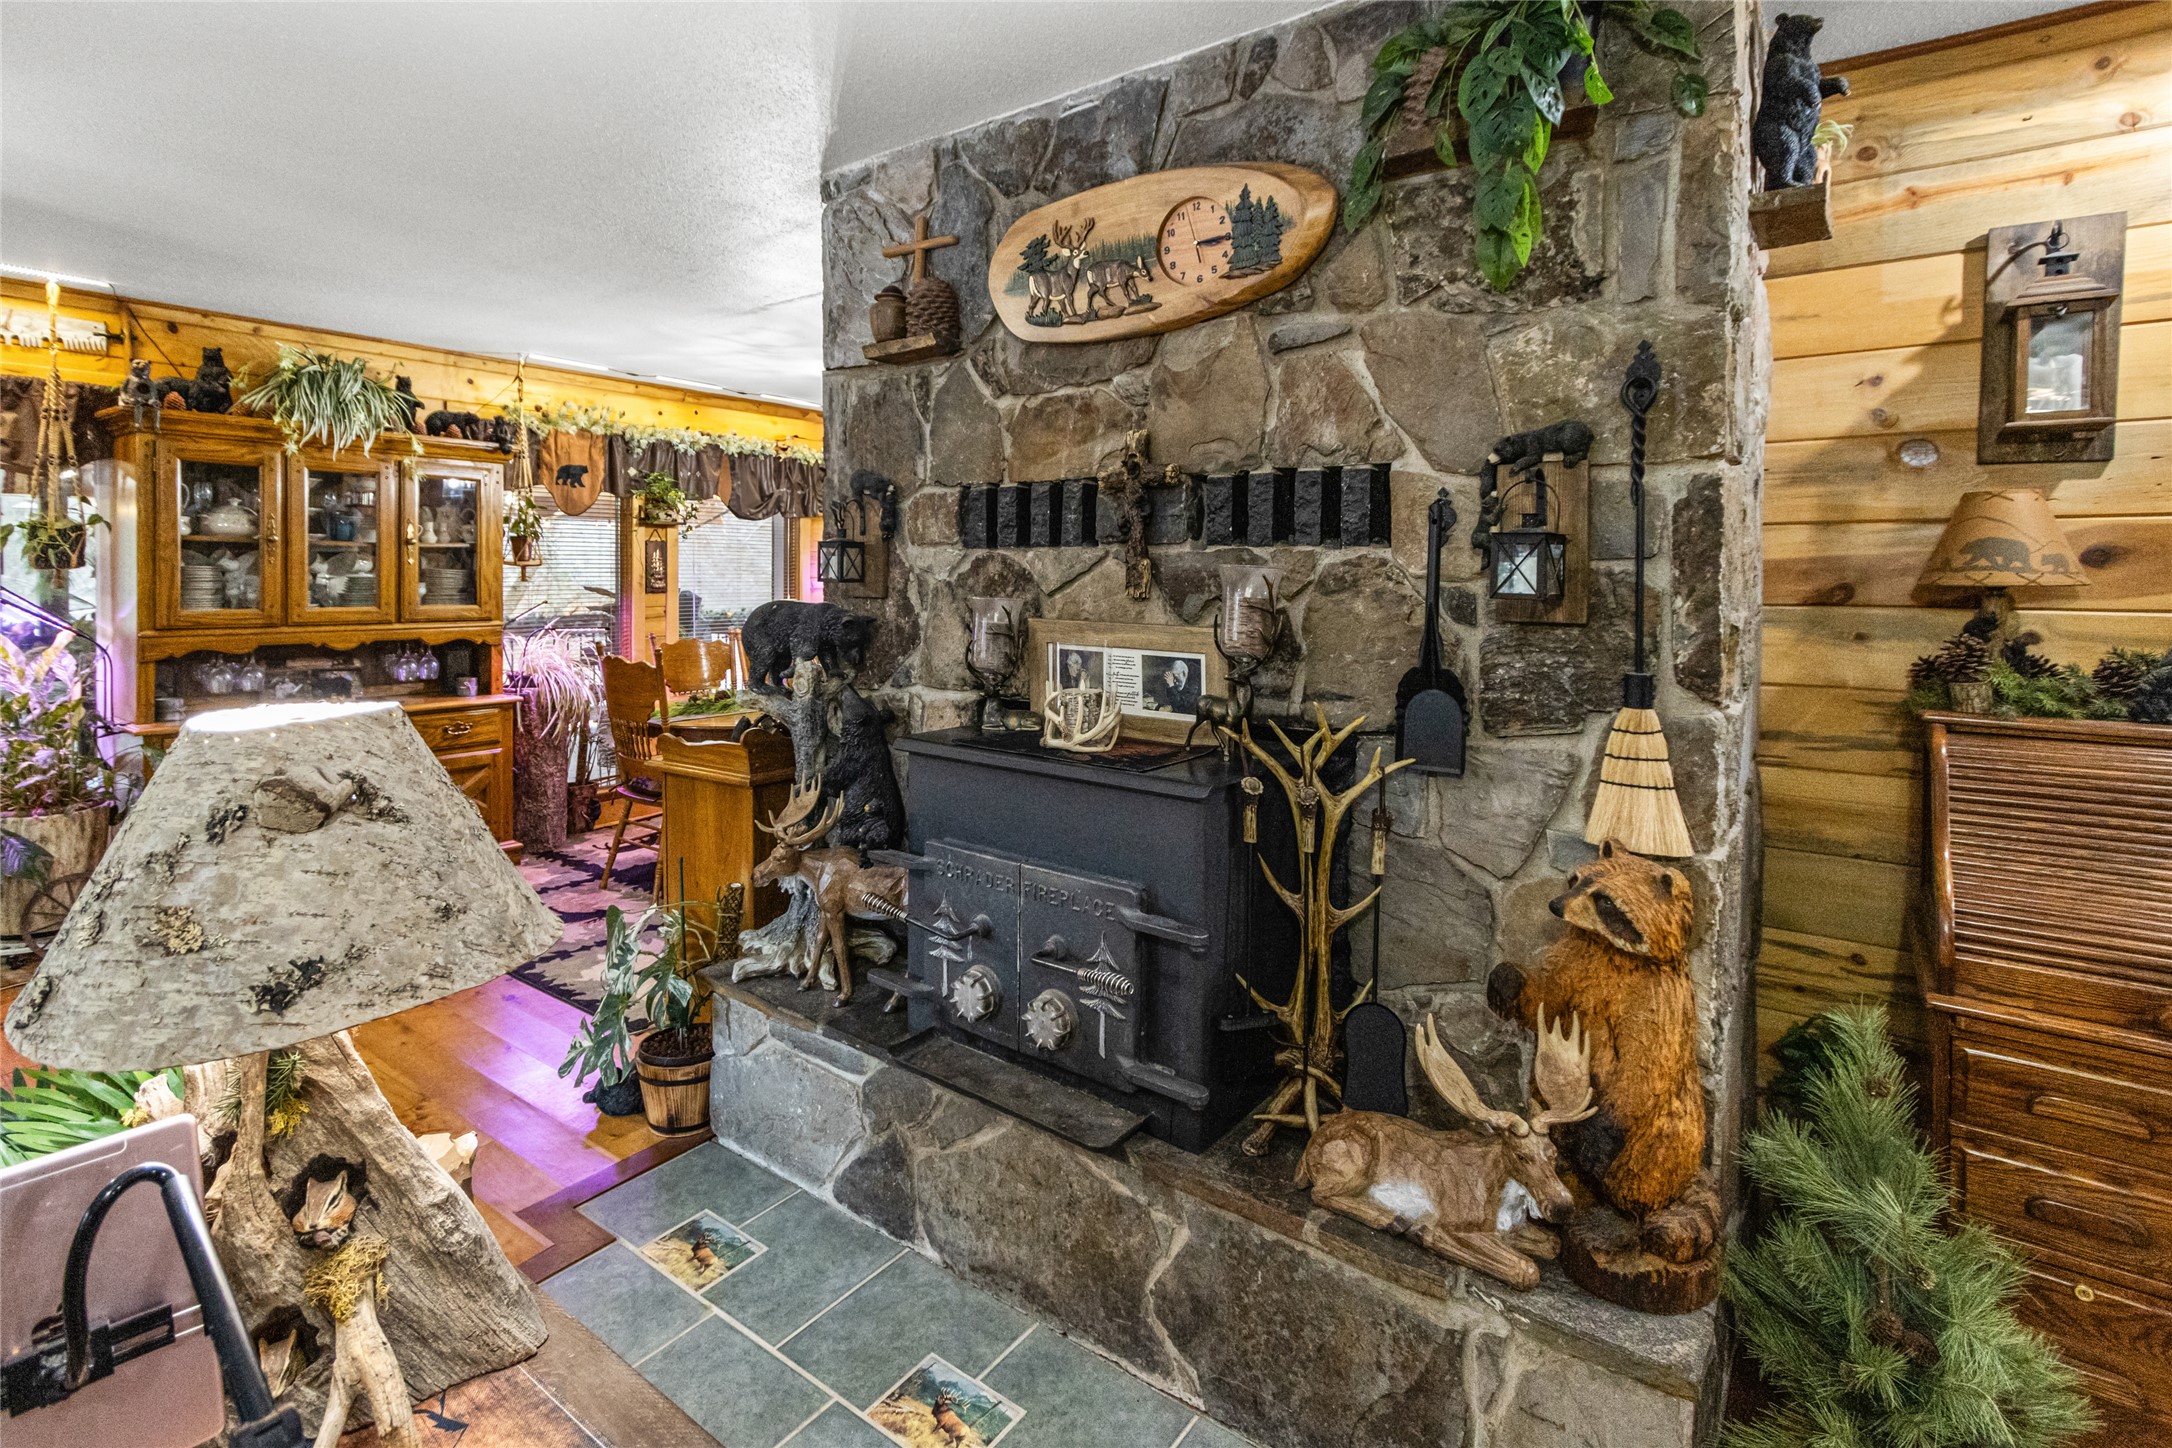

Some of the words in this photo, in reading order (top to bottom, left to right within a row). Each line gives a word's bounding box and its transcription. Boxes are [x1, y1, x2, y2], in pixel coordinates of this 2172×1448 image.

[1192, 201, 1201, 212] 12
[1177, 212, 1185, 221] 11
[1219, 216, 1225, 225] 2
[1167, 228, 1175, 237] 10
[1164, 246, 1171, 254] 9
[1222, 250, 1228, 258] 4
[1169, 261, 1176, 270] 8
[1211, 265, 1218, 274] 5
[1180, 272, 1186, 280] 7
[1197, 275, 1203, 283] 6
[936, 858, 1015, 894] SCHRADER
[1024, 880, 1115, 921] FIREPLACE
